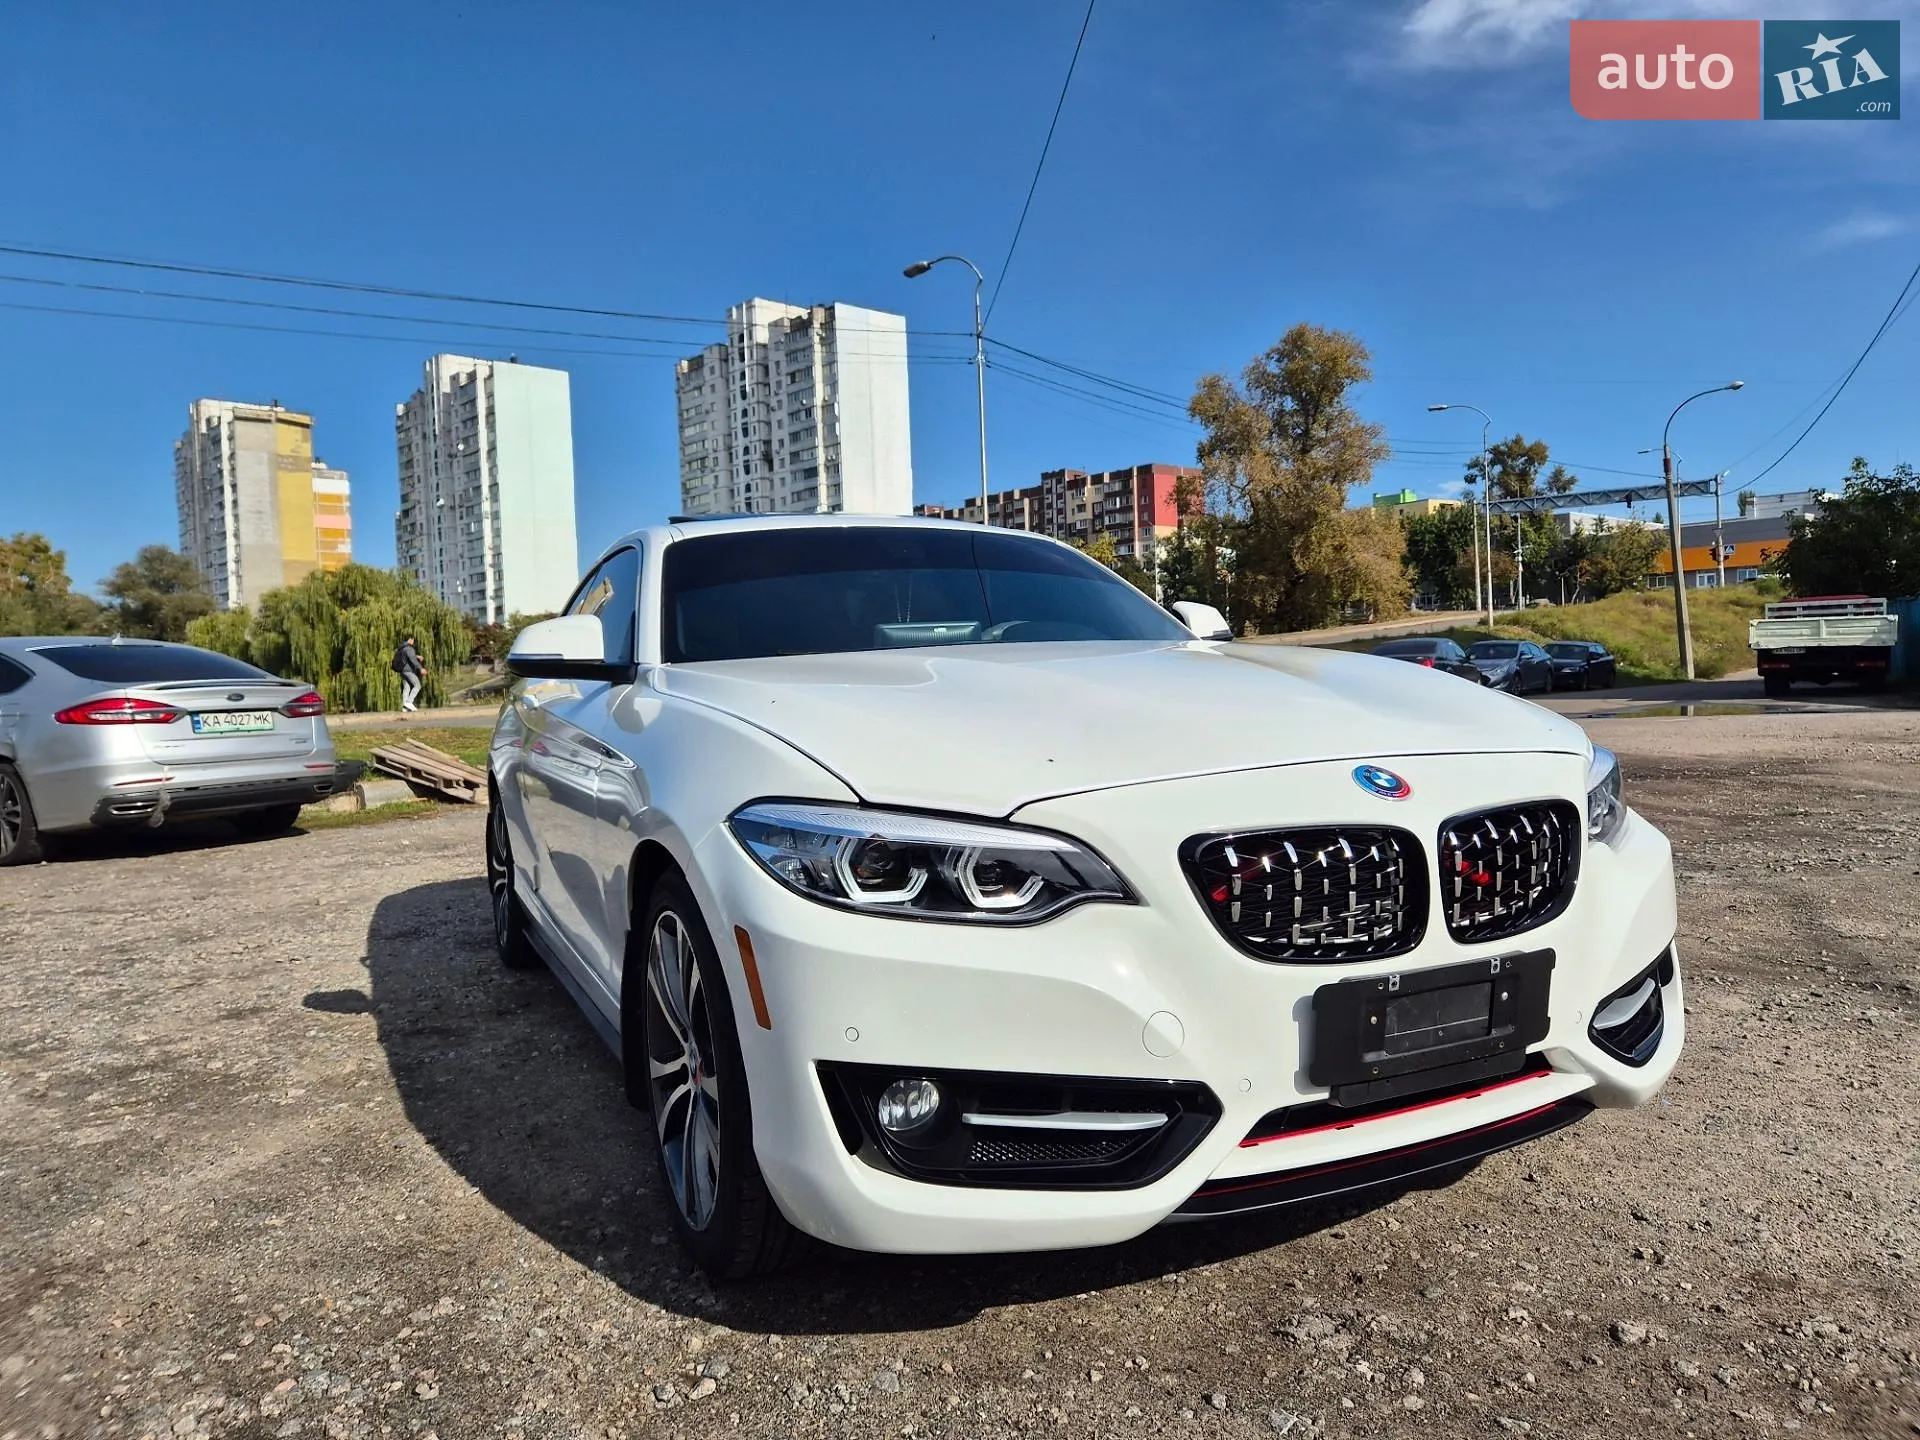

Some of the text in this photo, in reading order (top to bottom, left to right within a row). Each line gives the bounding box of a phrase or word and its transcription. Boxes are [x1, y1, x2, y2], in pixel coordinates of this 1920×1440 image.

[201, 713, 272, 727] KA 4027 MK
